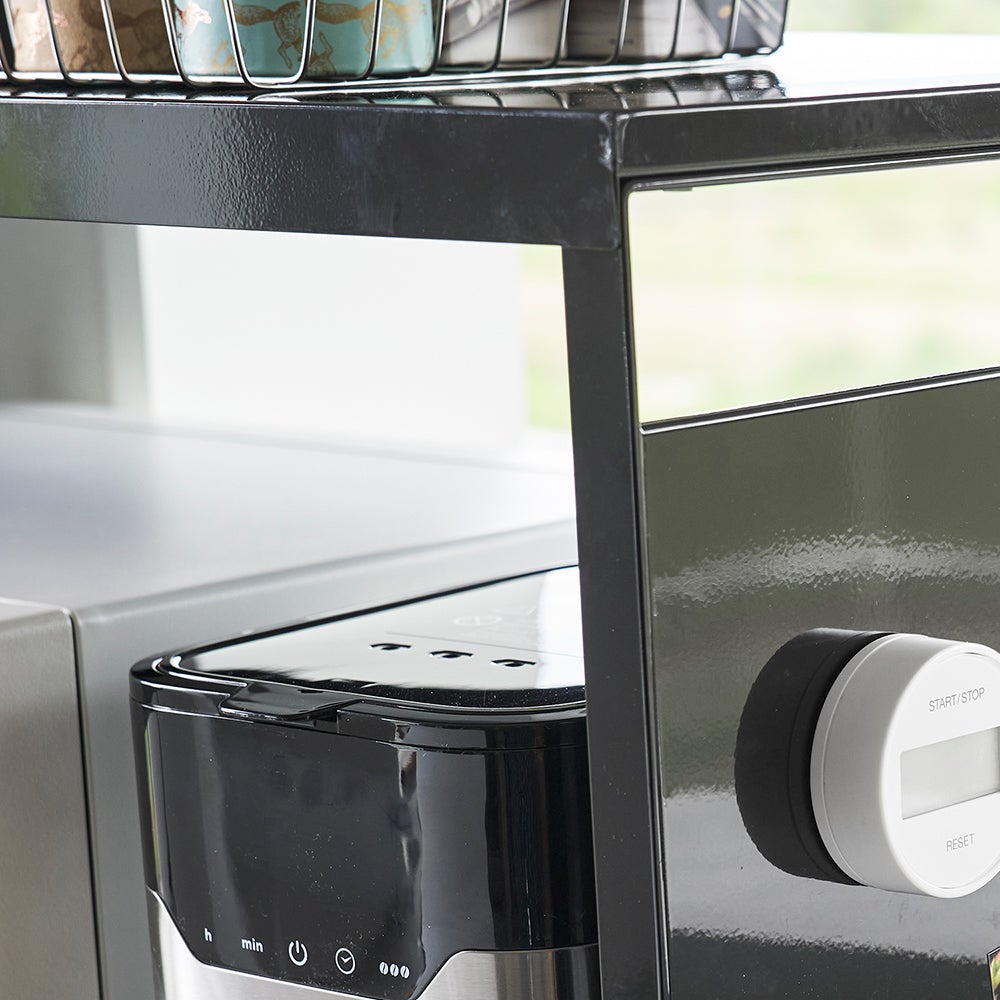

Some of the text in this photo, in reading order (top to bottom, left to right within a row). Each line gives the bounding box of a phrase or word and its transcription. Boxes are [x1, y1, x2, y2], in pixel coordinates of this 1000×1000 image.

[928, 686, 985, 712] START/STOP
[946, 833, 975, 852] RESET
[204, 927, 213, 942] h
[241, 937, 264, 952] min
